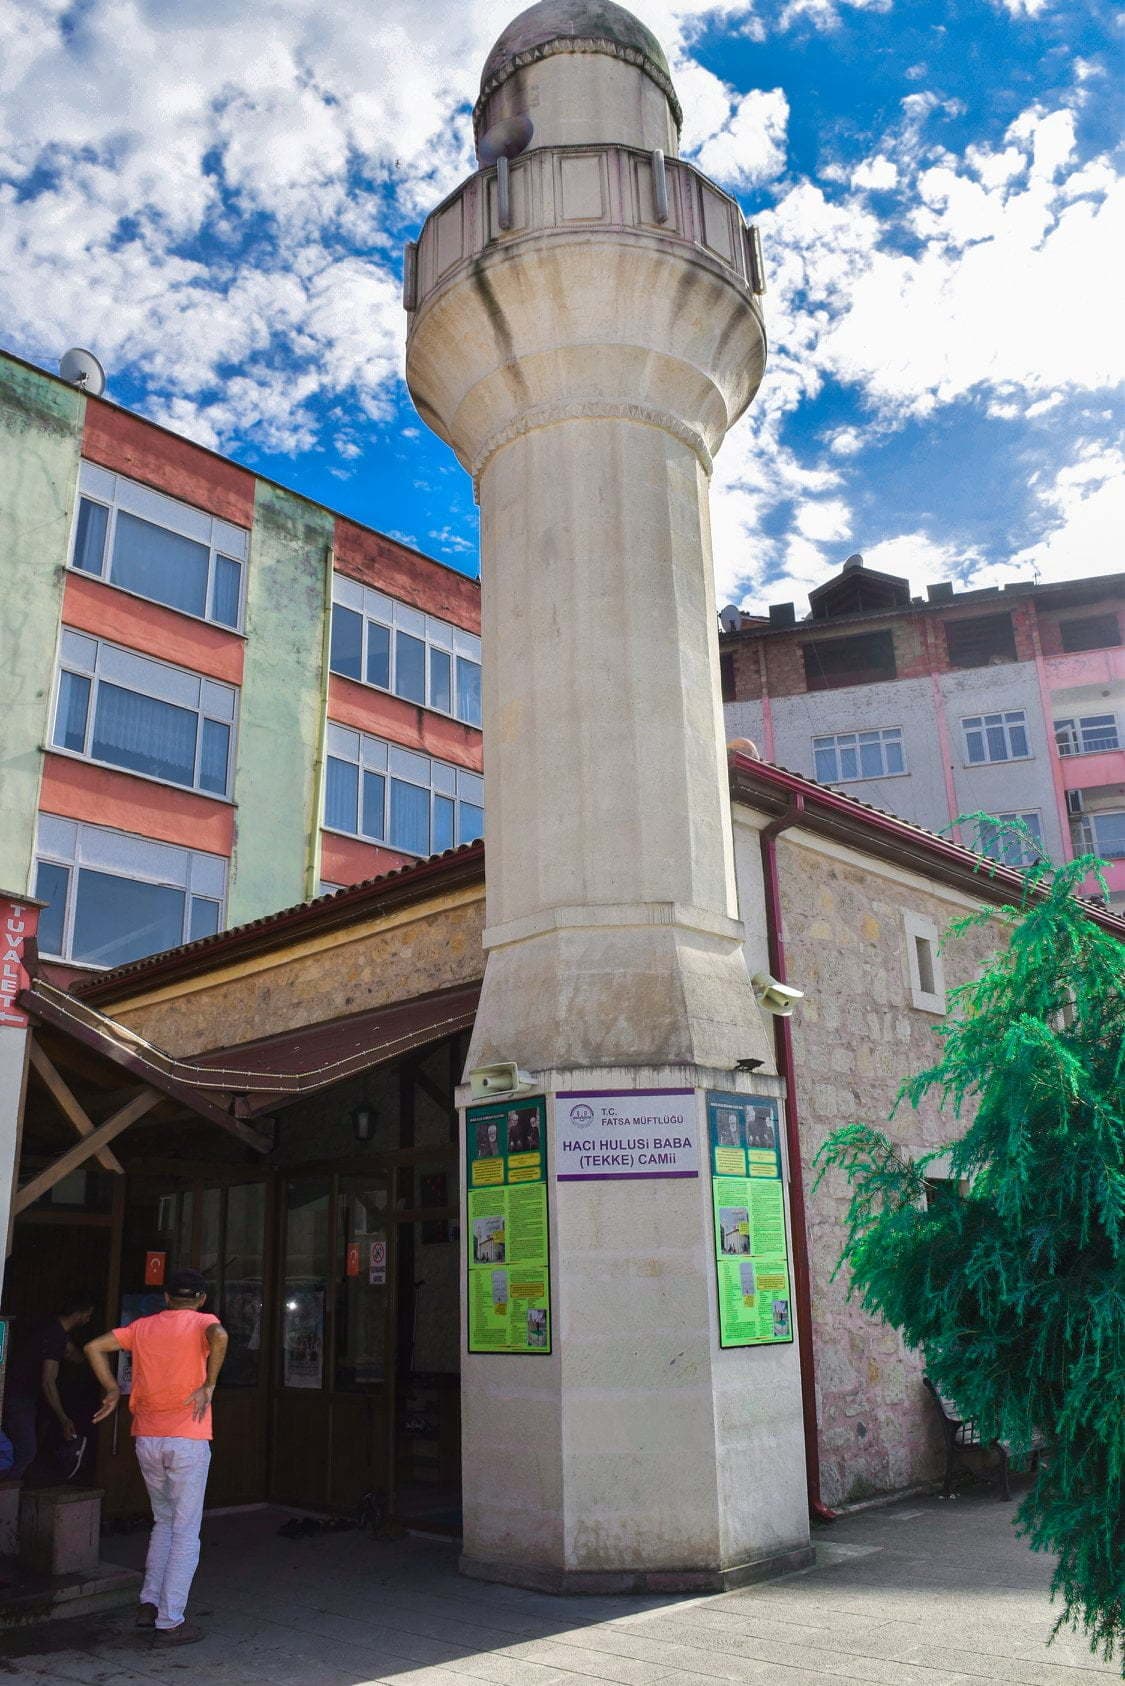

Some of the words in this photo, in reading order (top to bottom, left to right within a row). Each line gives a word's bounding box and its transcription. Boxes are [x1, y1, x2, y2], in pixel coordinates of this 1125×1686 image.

[0, 904, 26, 1008] TUVALET
[601, 1108, 617, 1116] T.C.
[601, 1117, 631, 1126] FATSA
[563, 1140, 596, 1151] HACI
[653, 1137, 692, 1149] BABA
[580, 1154, 634, 1168] (TEKKE)
